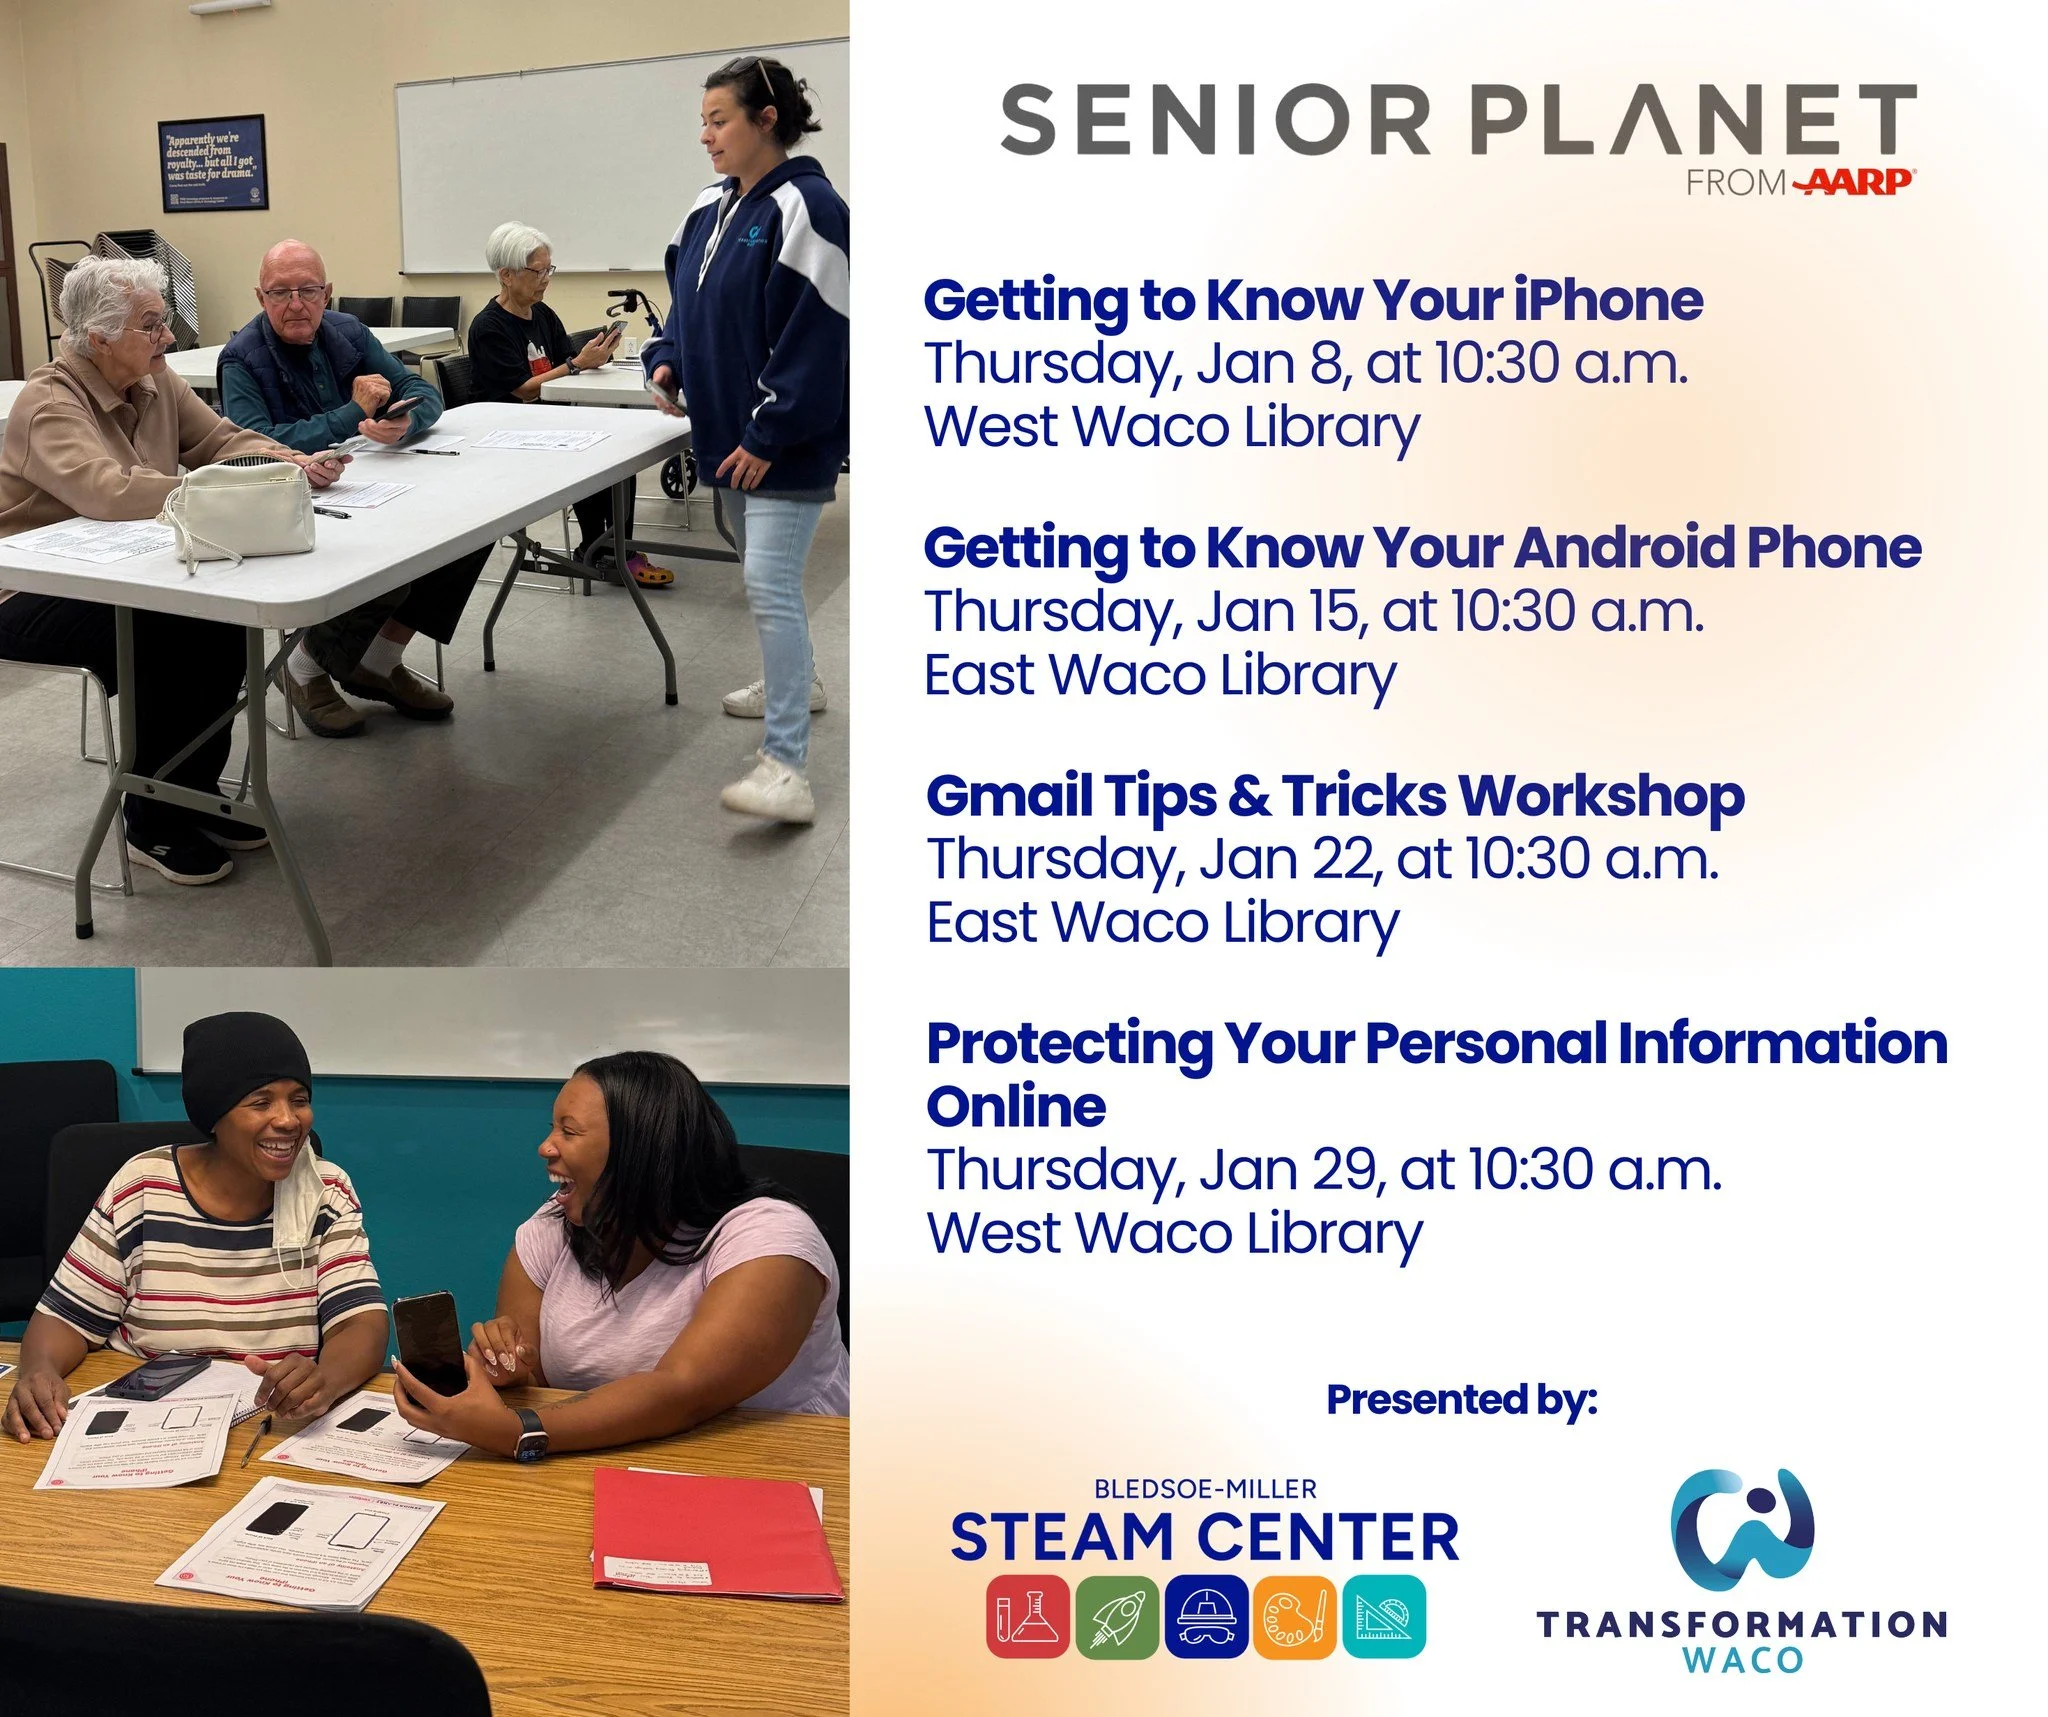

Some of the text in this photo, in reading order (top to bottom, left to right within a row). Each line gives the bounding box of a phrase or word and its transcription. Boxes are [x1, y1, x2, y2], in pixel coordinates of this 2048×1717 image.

[217, 131, 239, 143] we're
[167, 144, 231, 158] descended from
[204, 156, 219, 167] but
[220, 155, 233, 166] all
[238, 155, 253, 169] got
[168, 171, 185, 181] was
[185, 169, 206, 180] taste
[206, 168, 221, 182] for
[259, 1576, 289, 1584] iPhone
[283, 1583, 316, 1593] Getting
